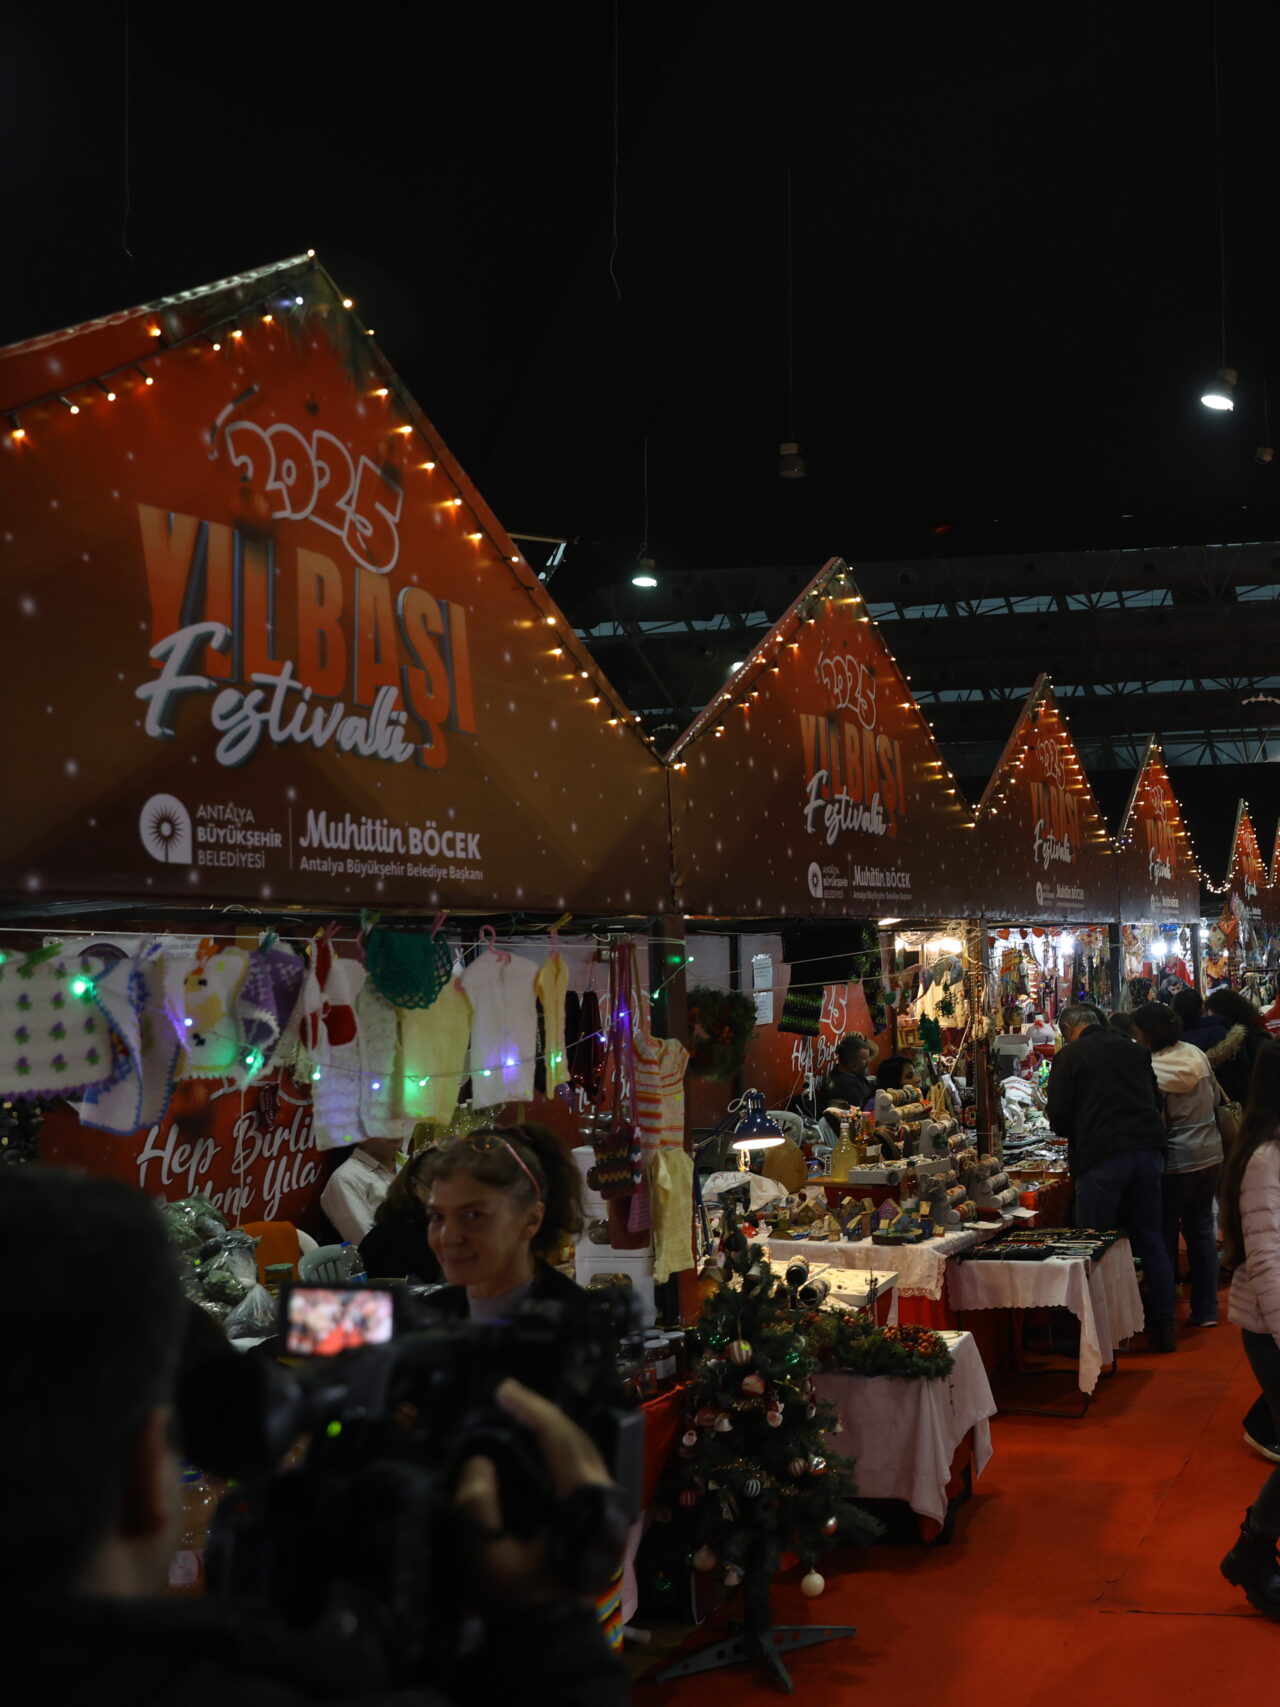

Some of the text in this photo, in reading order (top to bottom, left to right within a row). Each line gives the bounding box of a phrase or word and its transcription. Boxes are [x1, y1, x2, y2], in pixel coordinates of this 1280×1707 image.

[224, 419, 405, 575] 2025
[137, 502, 477, 770] YILBAŞI
[134, 620, 416, 769] Festivali
[820, 654, 877, 731] 2025
[196, 823, 283, 849] BÜYÜKŞEHİR
[197, 847, 266, 869] BELEDİYESİ
[299, 808, 482, 860] Muhittin BÖCEK
[300, 856, 484, 883] Antalya Büyükşehir Belediye Başkanı
[885, 867, 912, 889] BÖCEK
[136, 1106, 317, 1194] Hep Birli
[262, 1152, 322, 1222] Yıla
